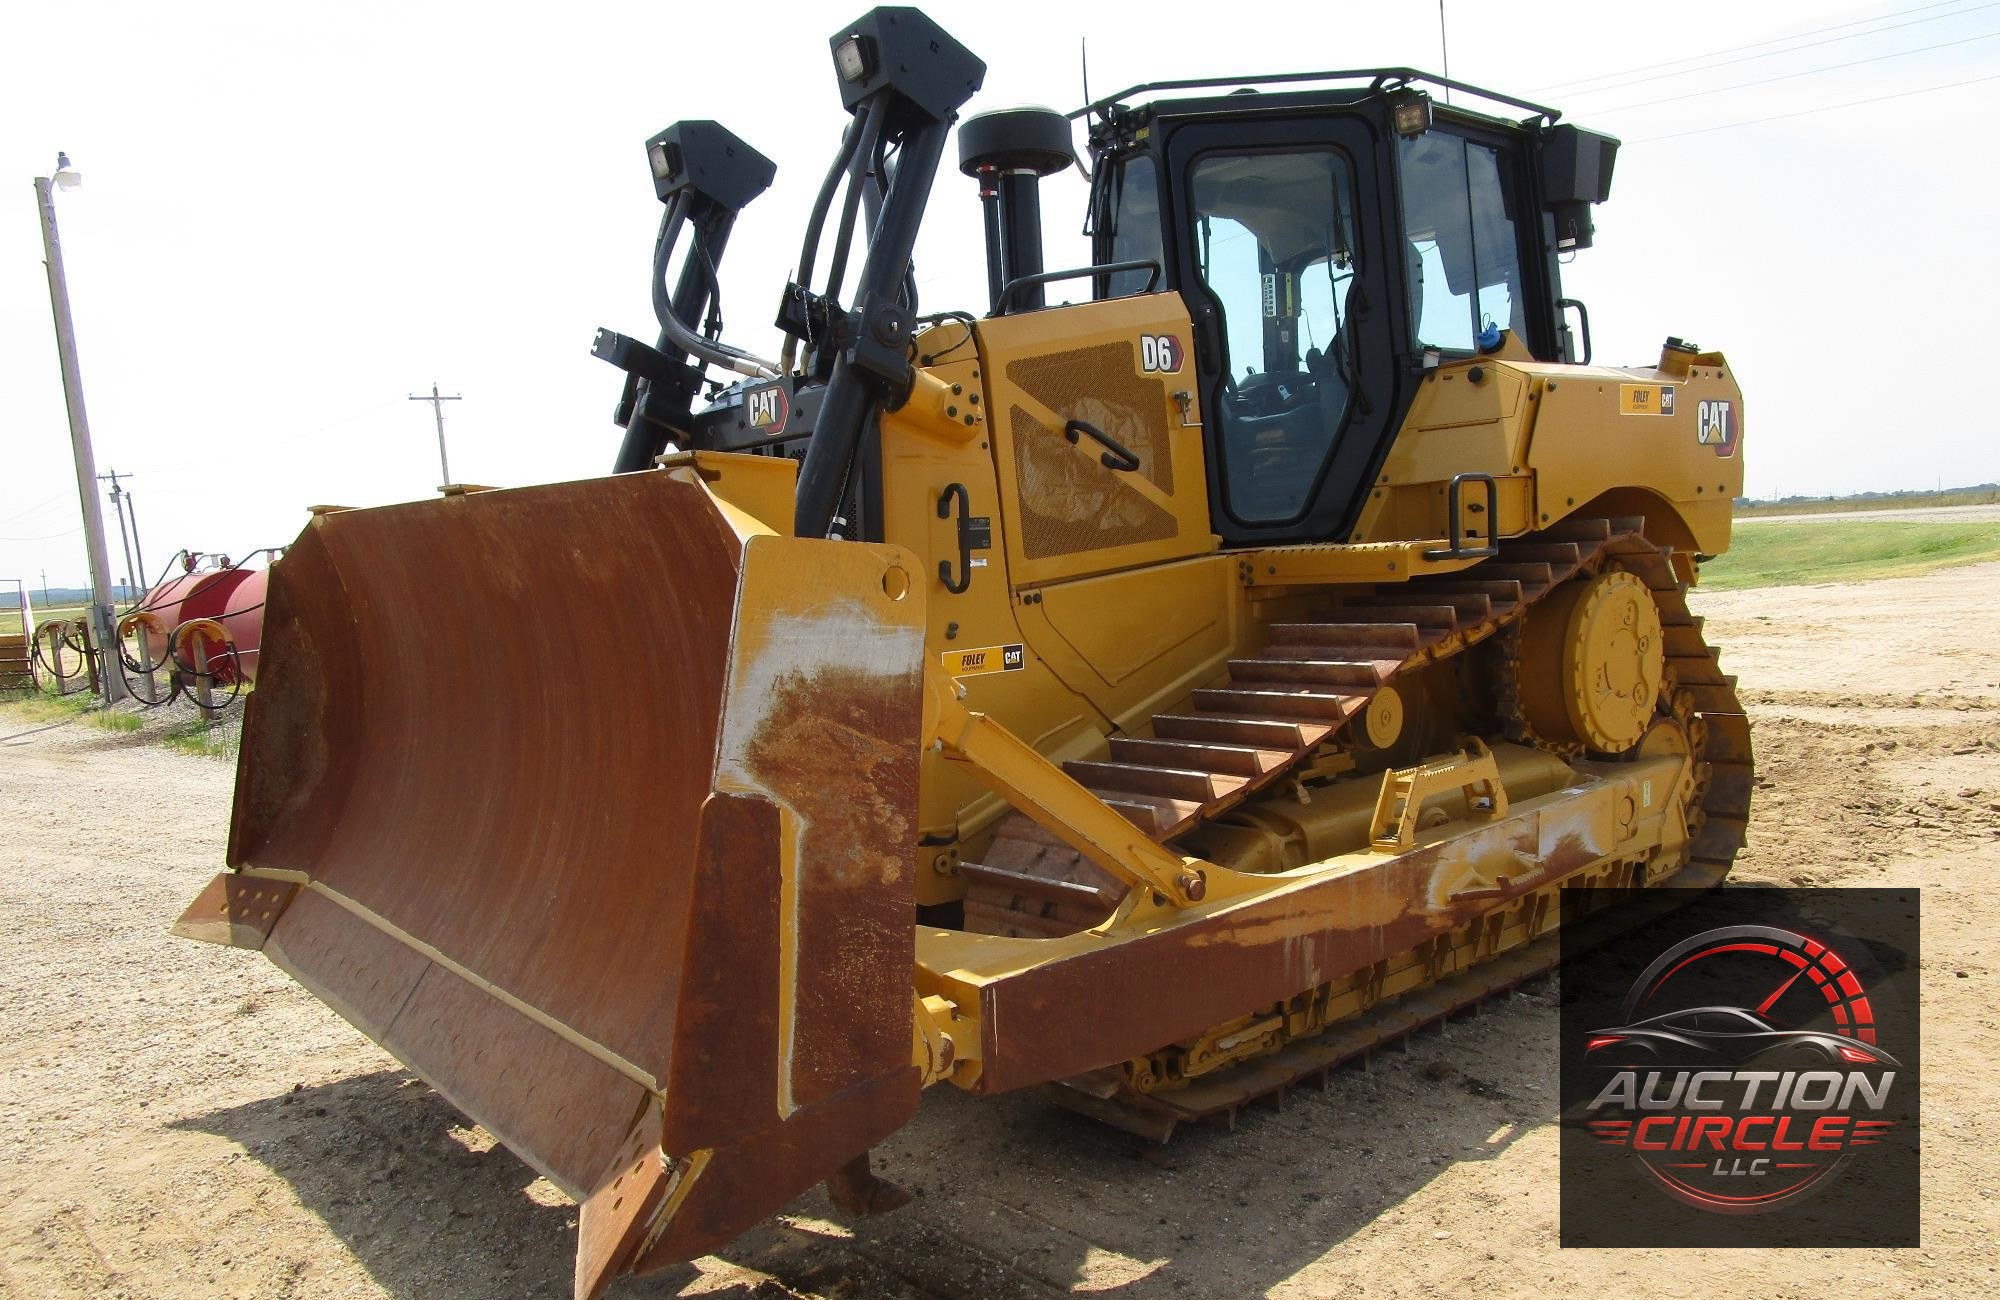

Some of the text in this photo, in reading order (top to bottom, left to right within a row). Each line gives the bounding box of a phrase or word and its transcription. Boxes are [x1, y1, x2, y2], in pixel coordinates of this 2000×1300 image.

[1141, 335, 1172, 371] D6
[749, 389, 778, 427] CAT
[1661, 393, 1673, 408] CAT
[1697, 400, 1729, 444] CAT
[961, 653, 986, 667] FOLEY
[1005, 651, 1021, 665] CAT
